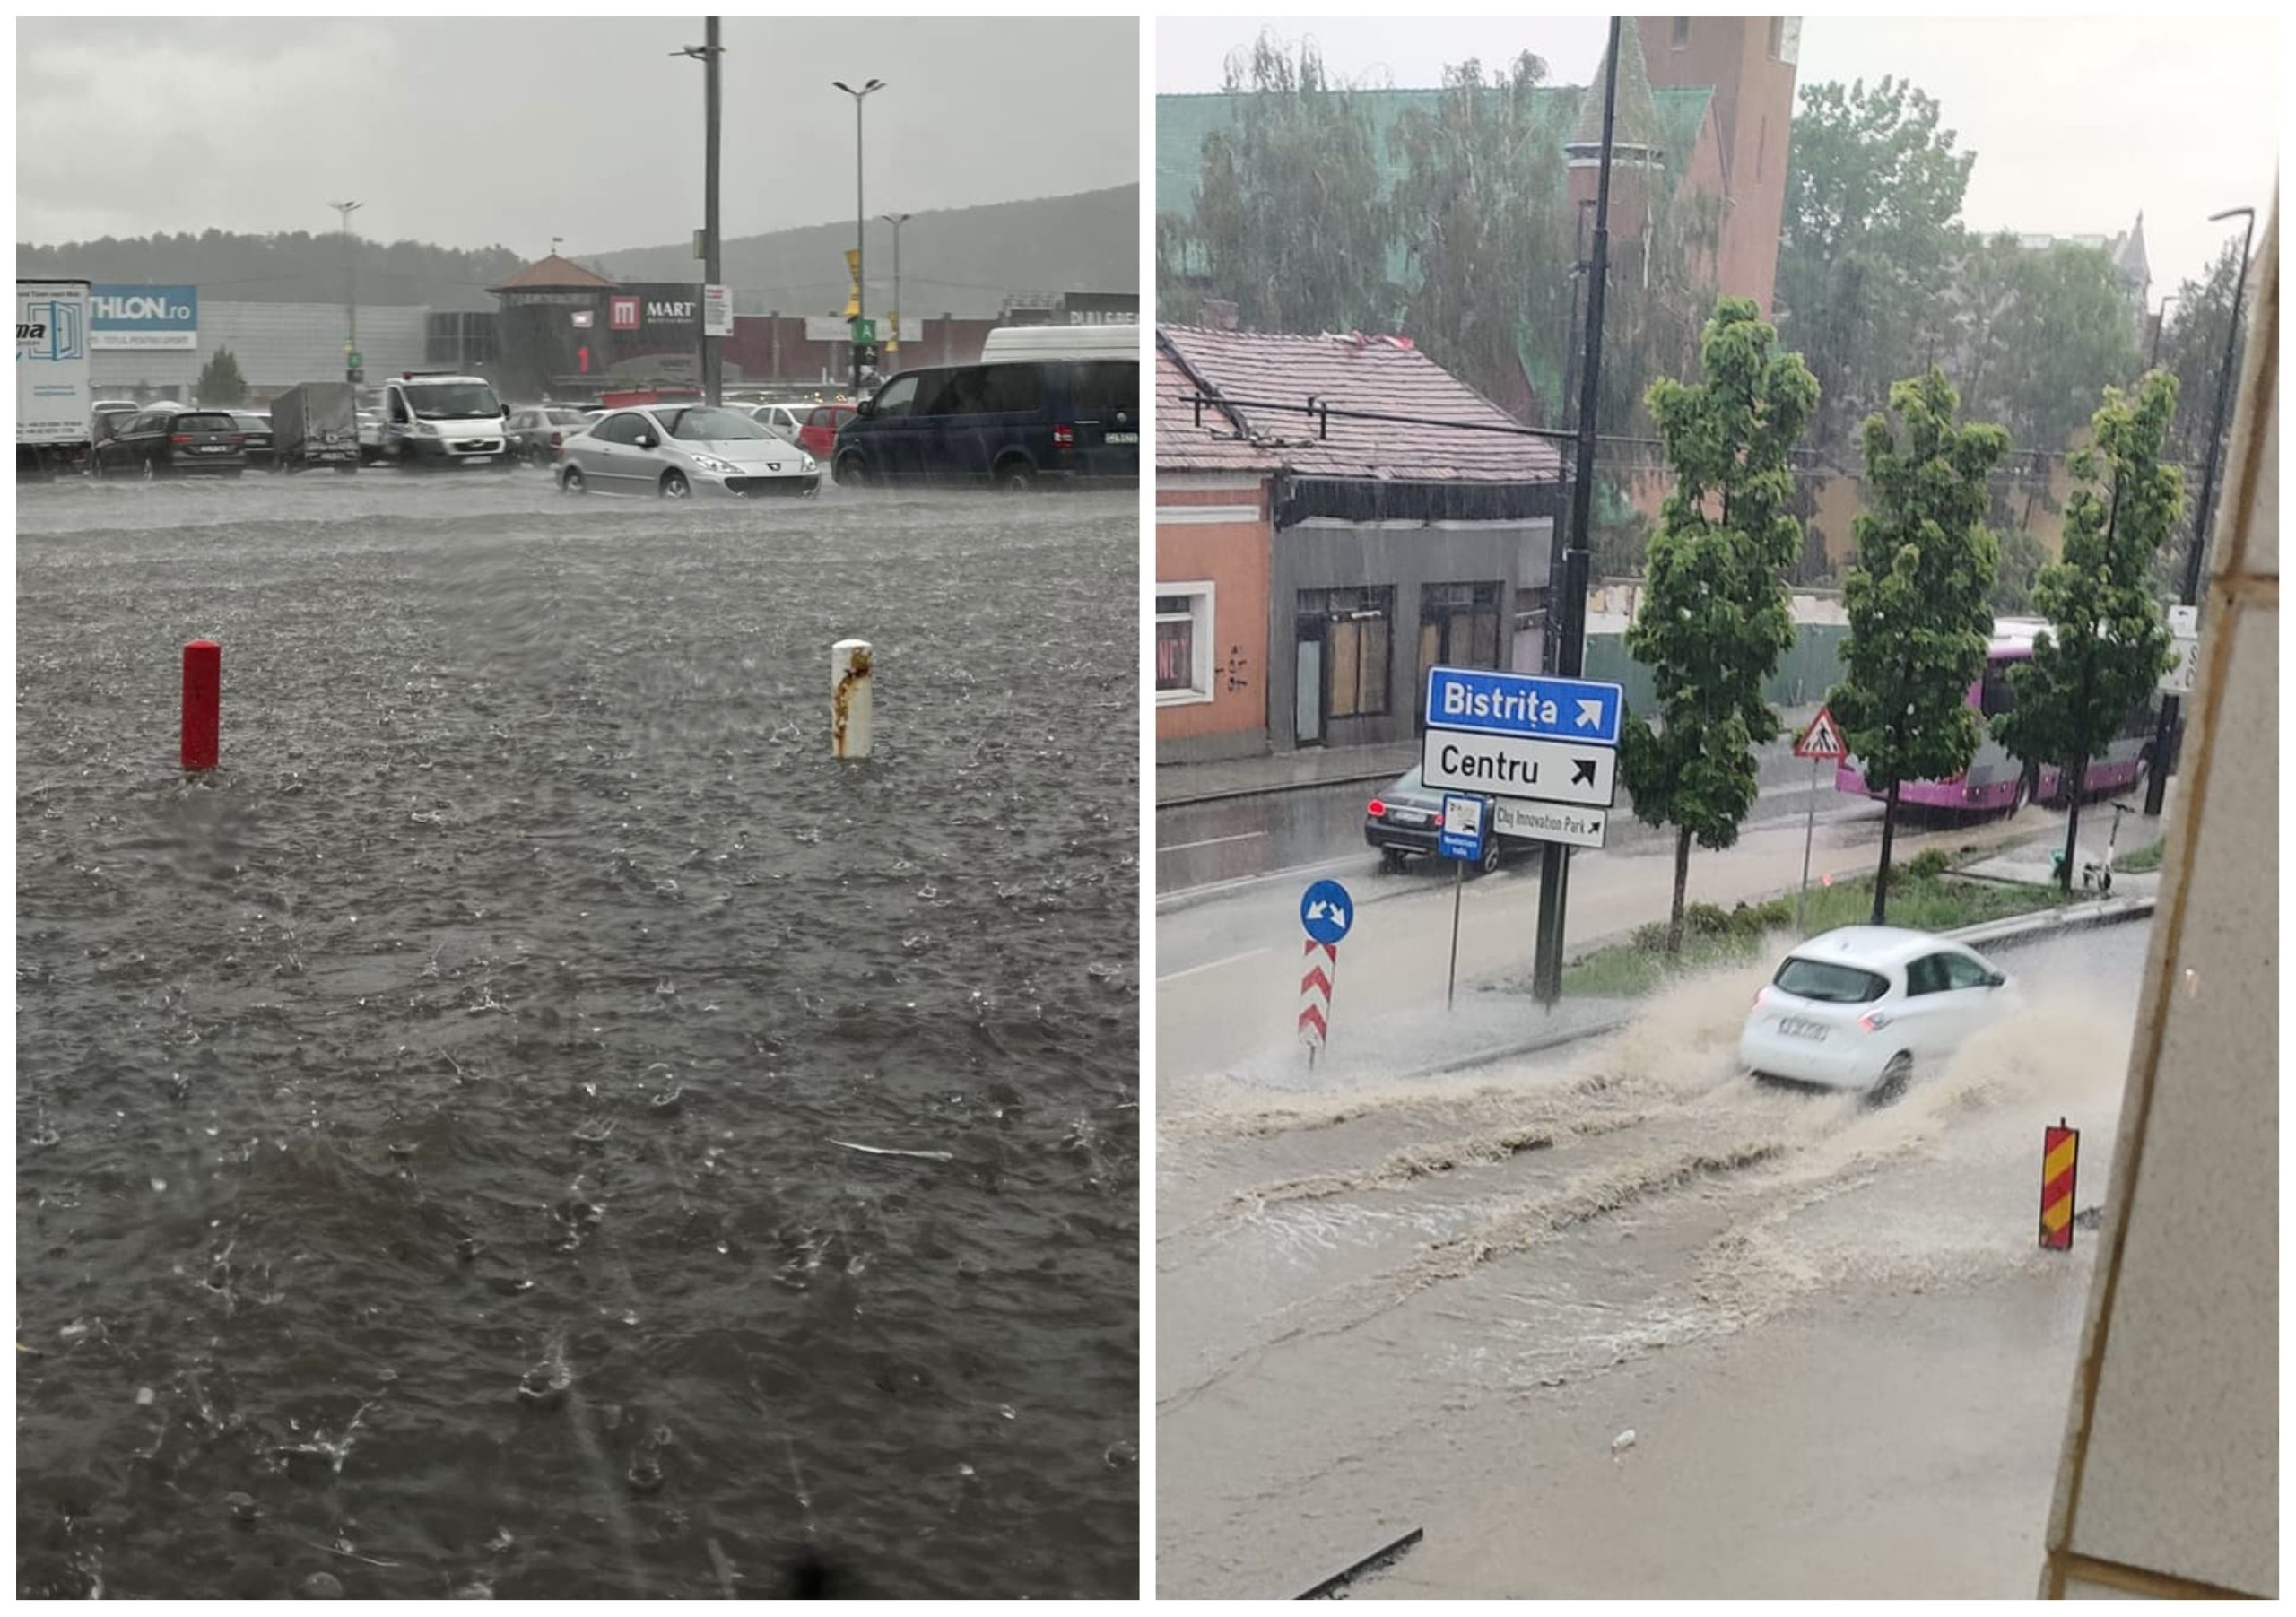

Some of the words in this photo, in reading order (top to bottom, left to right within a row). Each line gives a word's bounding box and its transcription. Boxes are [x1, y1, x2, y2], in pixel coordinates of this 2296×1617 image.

[647, 301, 696, 317] MART
[862, 324, 873, 338] A
[1444, 681, 1558, 728] Bistrița
[1441, 744, 1539, 784] Centru
[1497, 806, 1514, 829] Cluj
[1517, 810, 1561, 830] Innovation
[1564, 815, 1585, 833] Park
